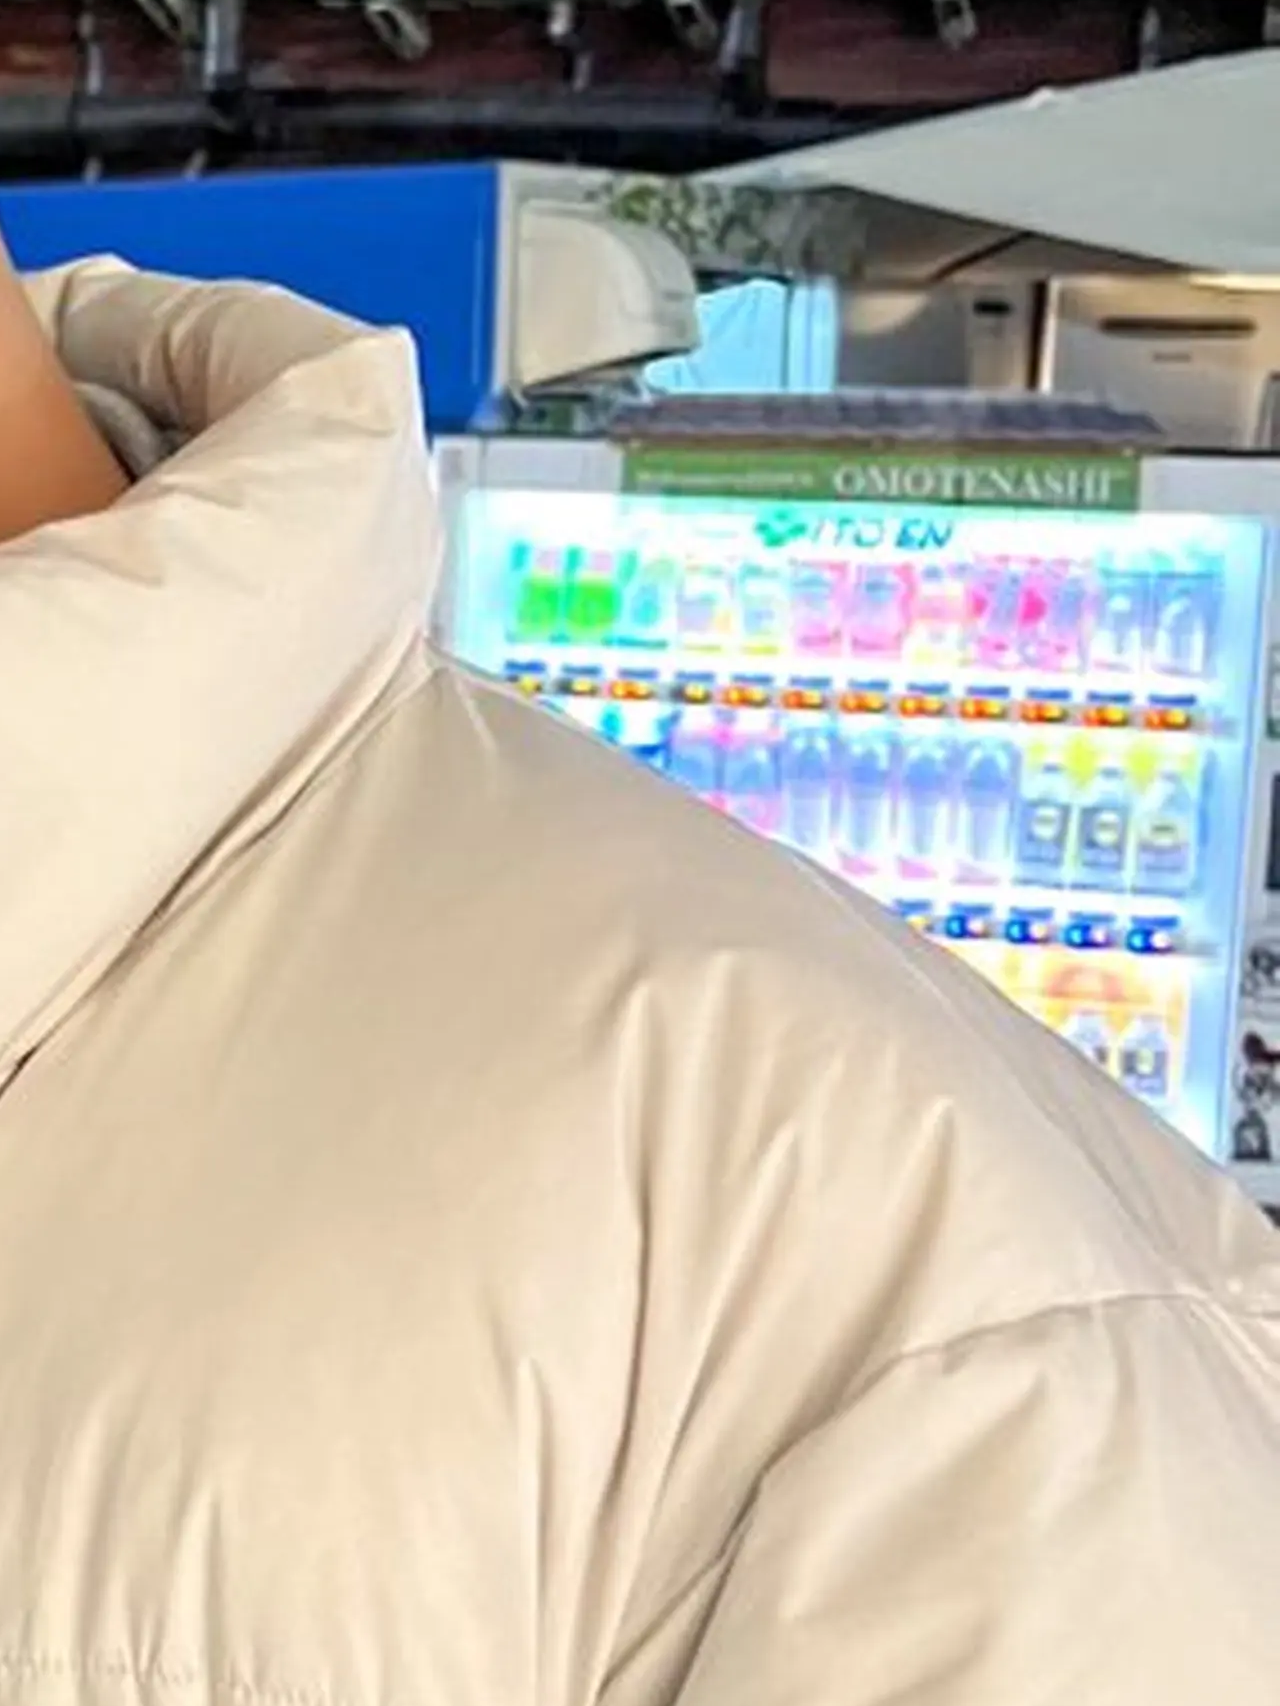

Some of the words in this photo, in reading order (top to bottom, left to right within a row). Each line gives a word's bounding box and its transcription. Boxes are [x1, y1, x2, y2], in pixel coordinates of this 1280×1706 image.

[834, 464, 1115, 503] OMOTENASHI
[810, 517, 887, 548] ITO
[894, 518, 954, 550] EN
